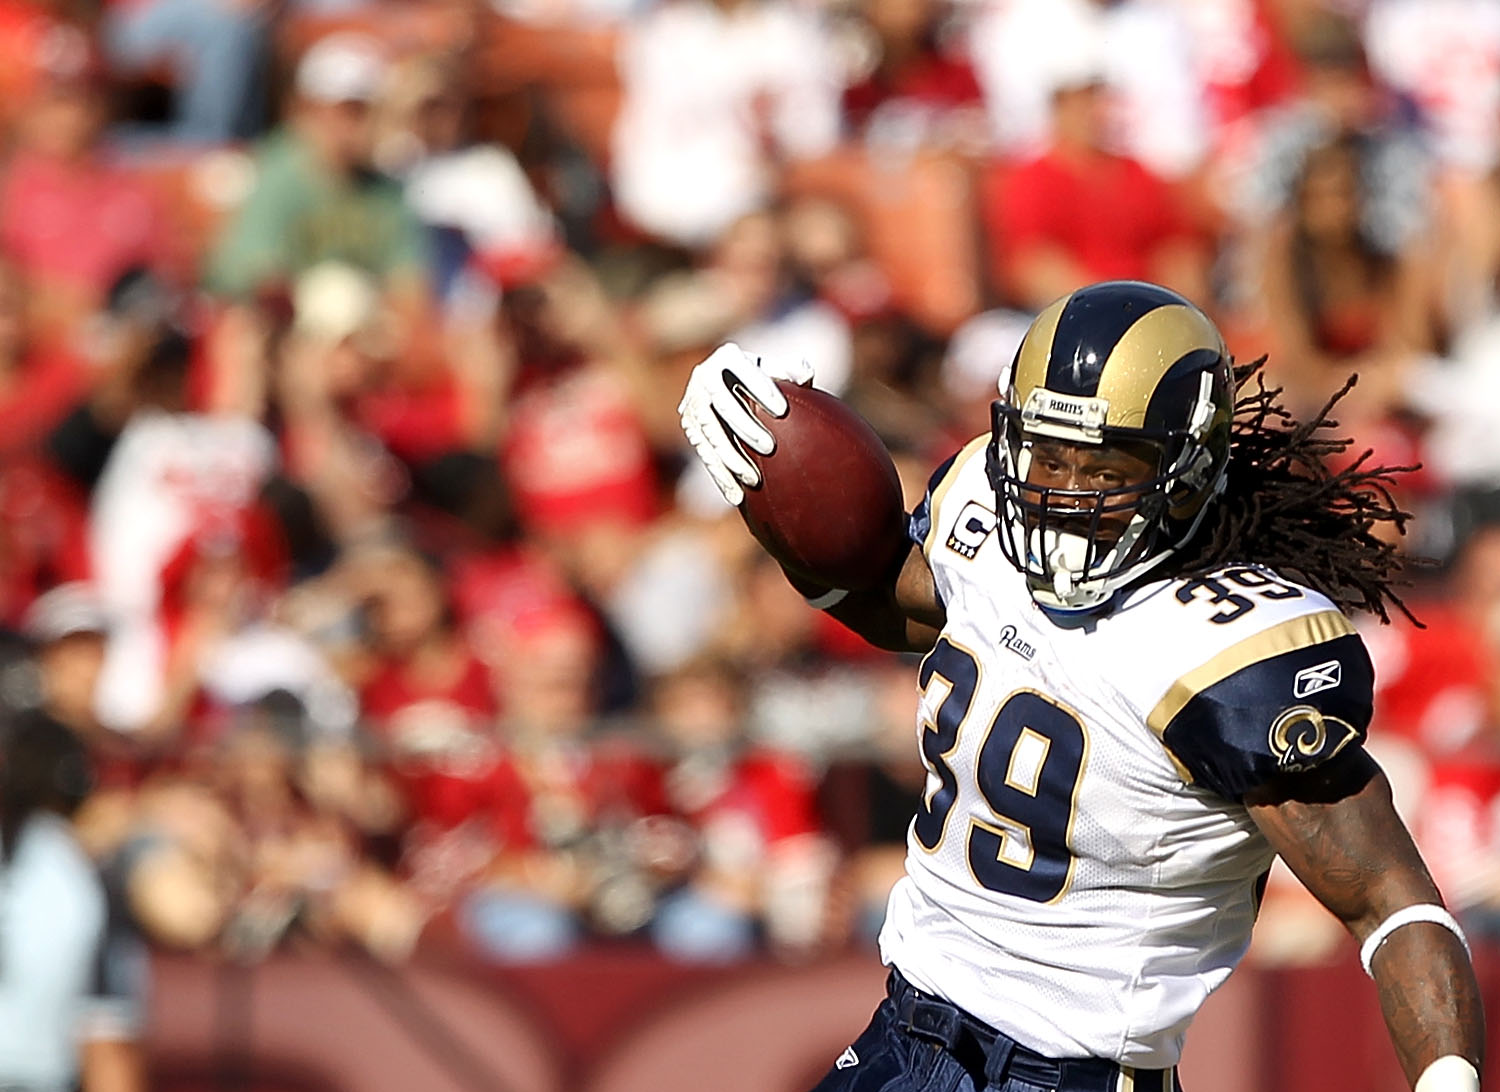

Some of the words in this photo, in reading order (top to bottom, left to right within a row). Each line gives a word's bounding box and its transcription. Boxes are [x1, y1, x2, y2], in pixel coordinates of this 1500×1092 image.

[1048, 399, 1084, 415] RAMS
[953, 501, 998, 549] C
[1175, 567, 1306, 625] 39
[998, 624, 1037, 662] Rams
[913, 633, 1090, 905] 39
